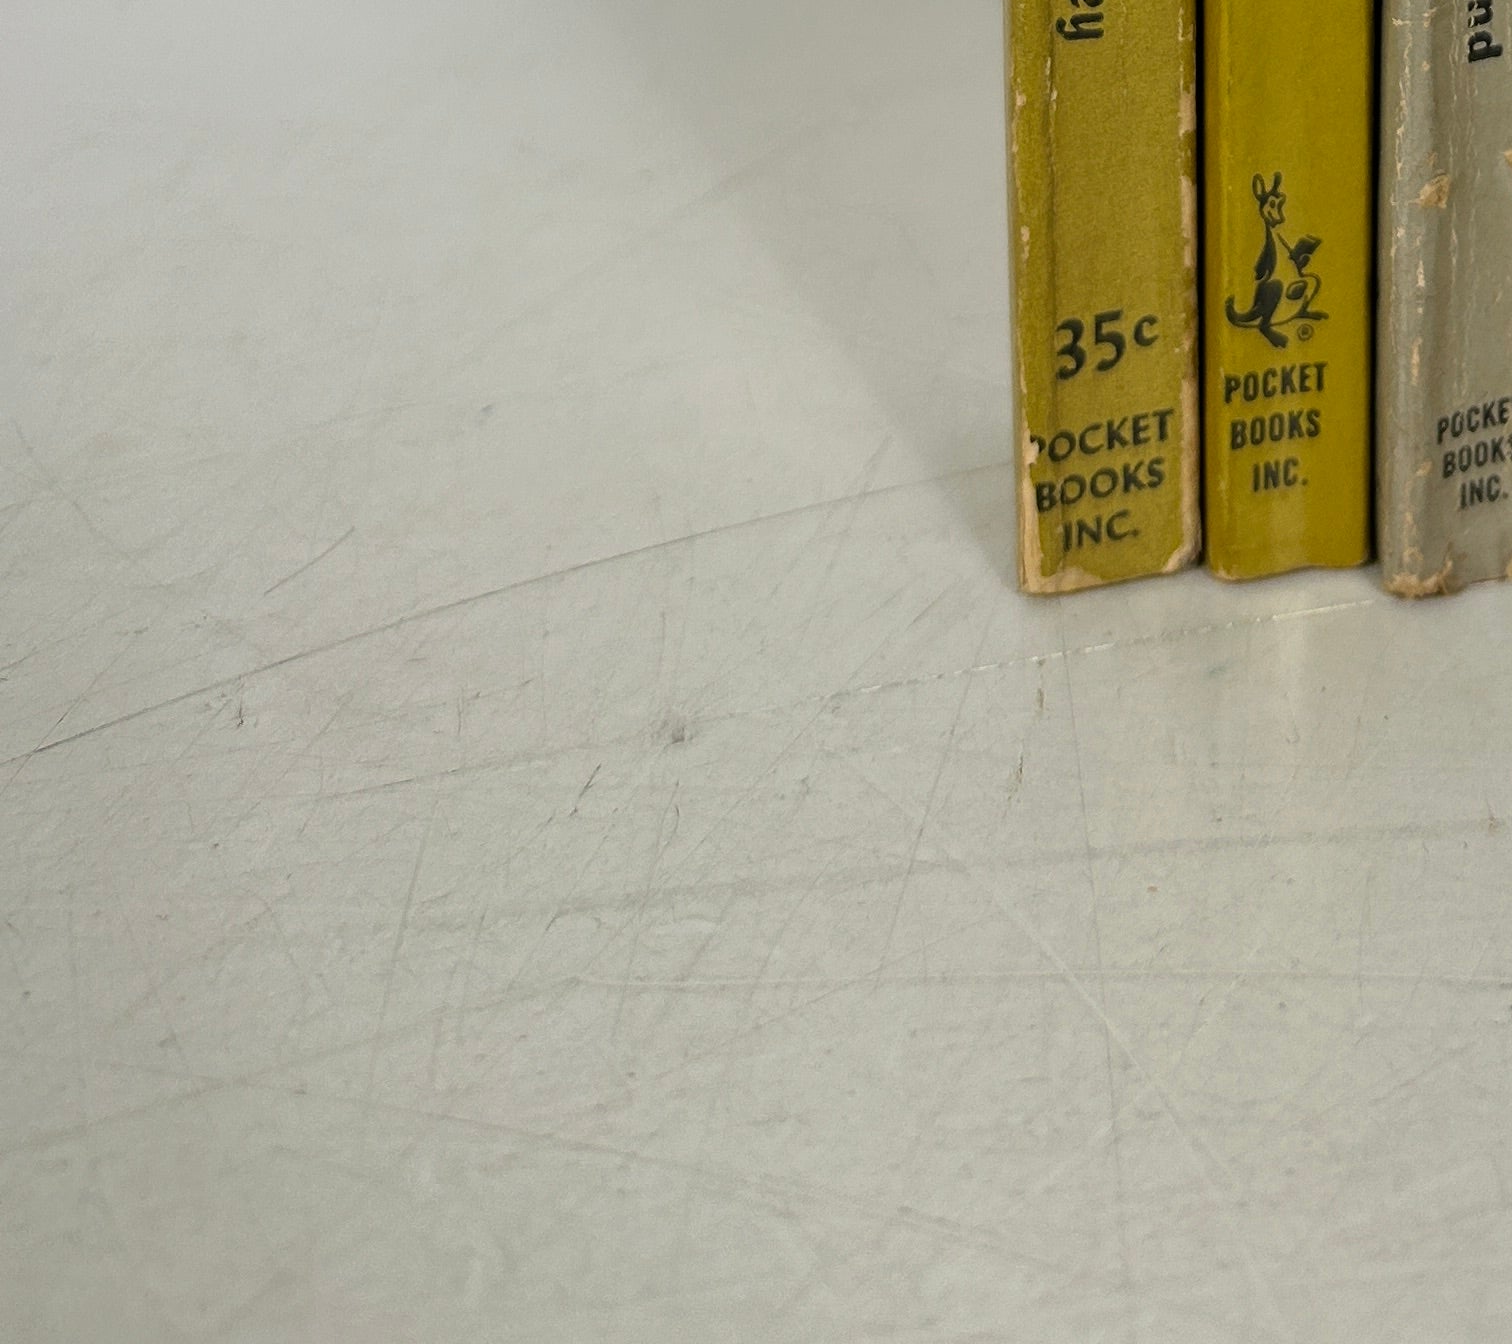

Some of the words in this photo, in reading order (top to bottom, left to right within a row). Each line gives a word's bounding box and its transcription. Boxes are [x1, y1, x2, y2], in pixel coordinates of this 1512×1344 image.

[1223, 361, 1328, 404] POCKET
[1229, 408, 1322, 451] BOOKS
[1035, 456, 1166, 514] BOOKS
[1252, 457, 1309, 493] INC.
[1459, 474, 1510, 510] INC.
[1061, 509, 1140, 553] INC.
